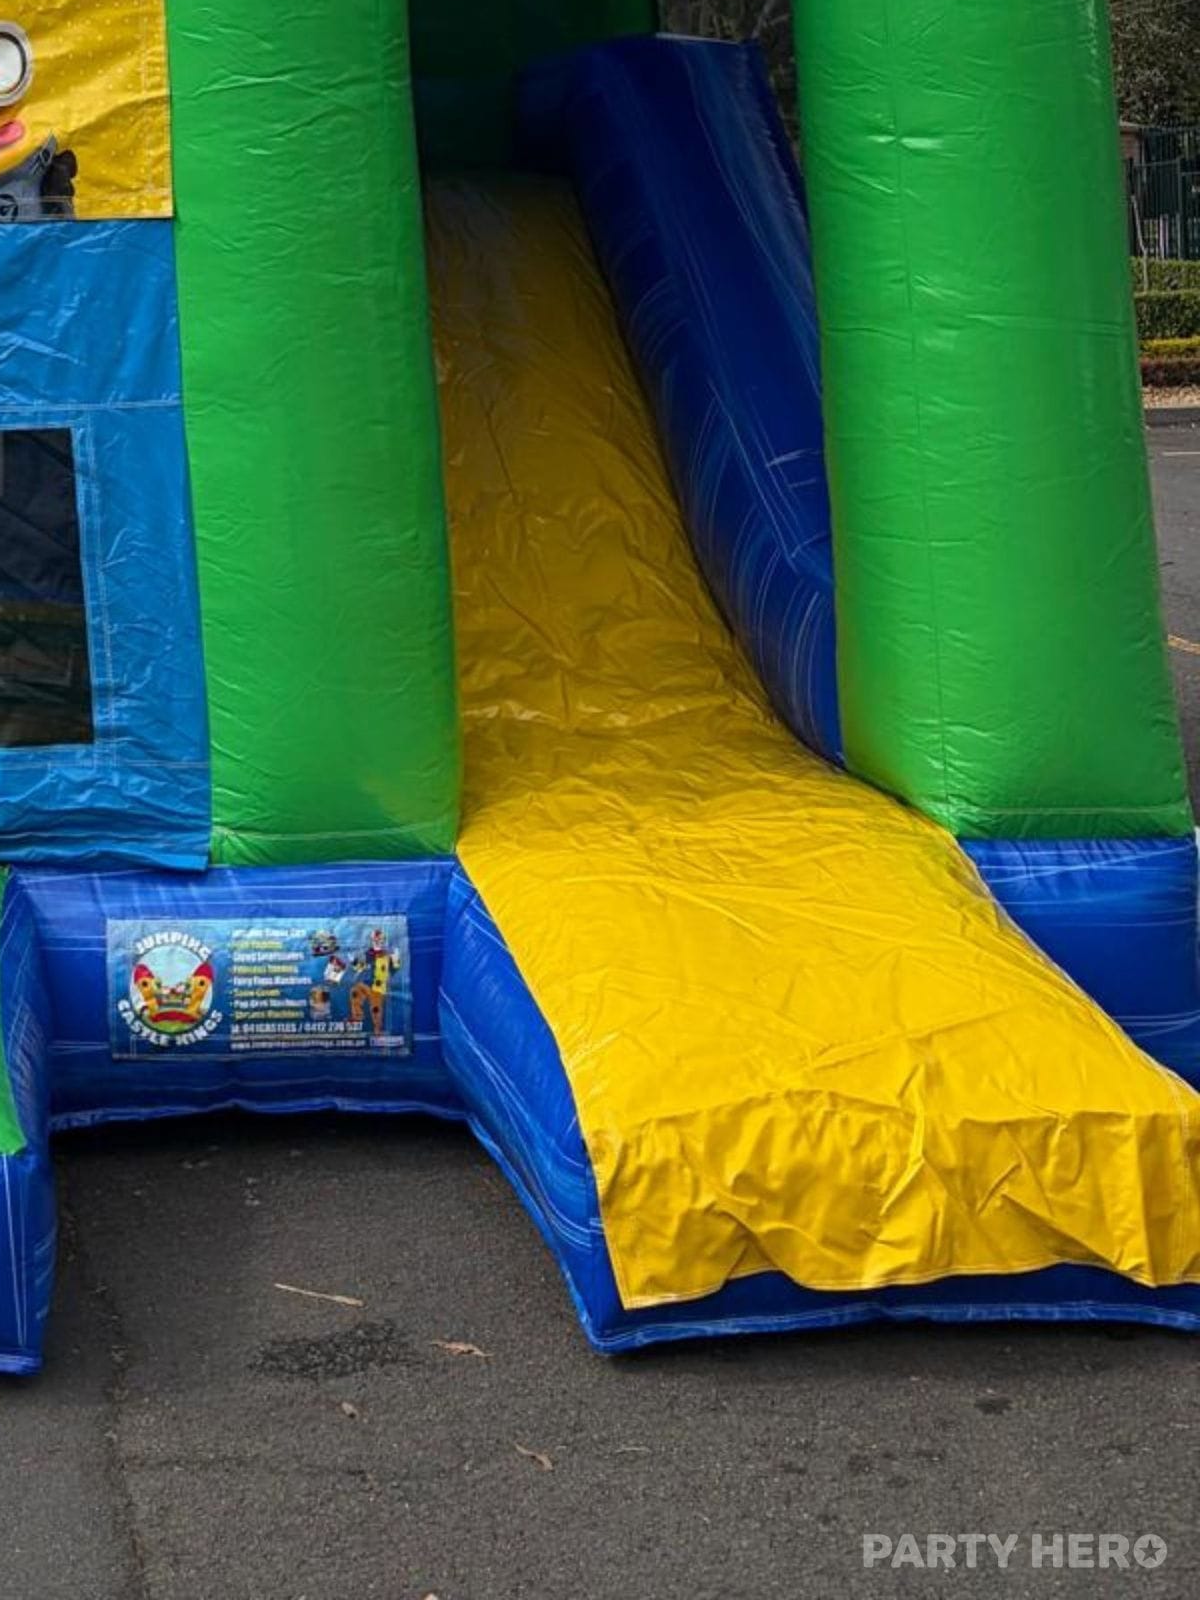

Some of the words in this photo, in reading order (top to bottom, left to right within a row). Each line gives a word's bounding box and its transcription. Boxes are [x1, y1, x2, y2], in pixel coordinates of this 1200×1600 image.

[135, 931, 211, 962] JUMPING
[118, 1000, 169, 1046] CASTLE
[175, 1010, 223, 1045] KINGS
